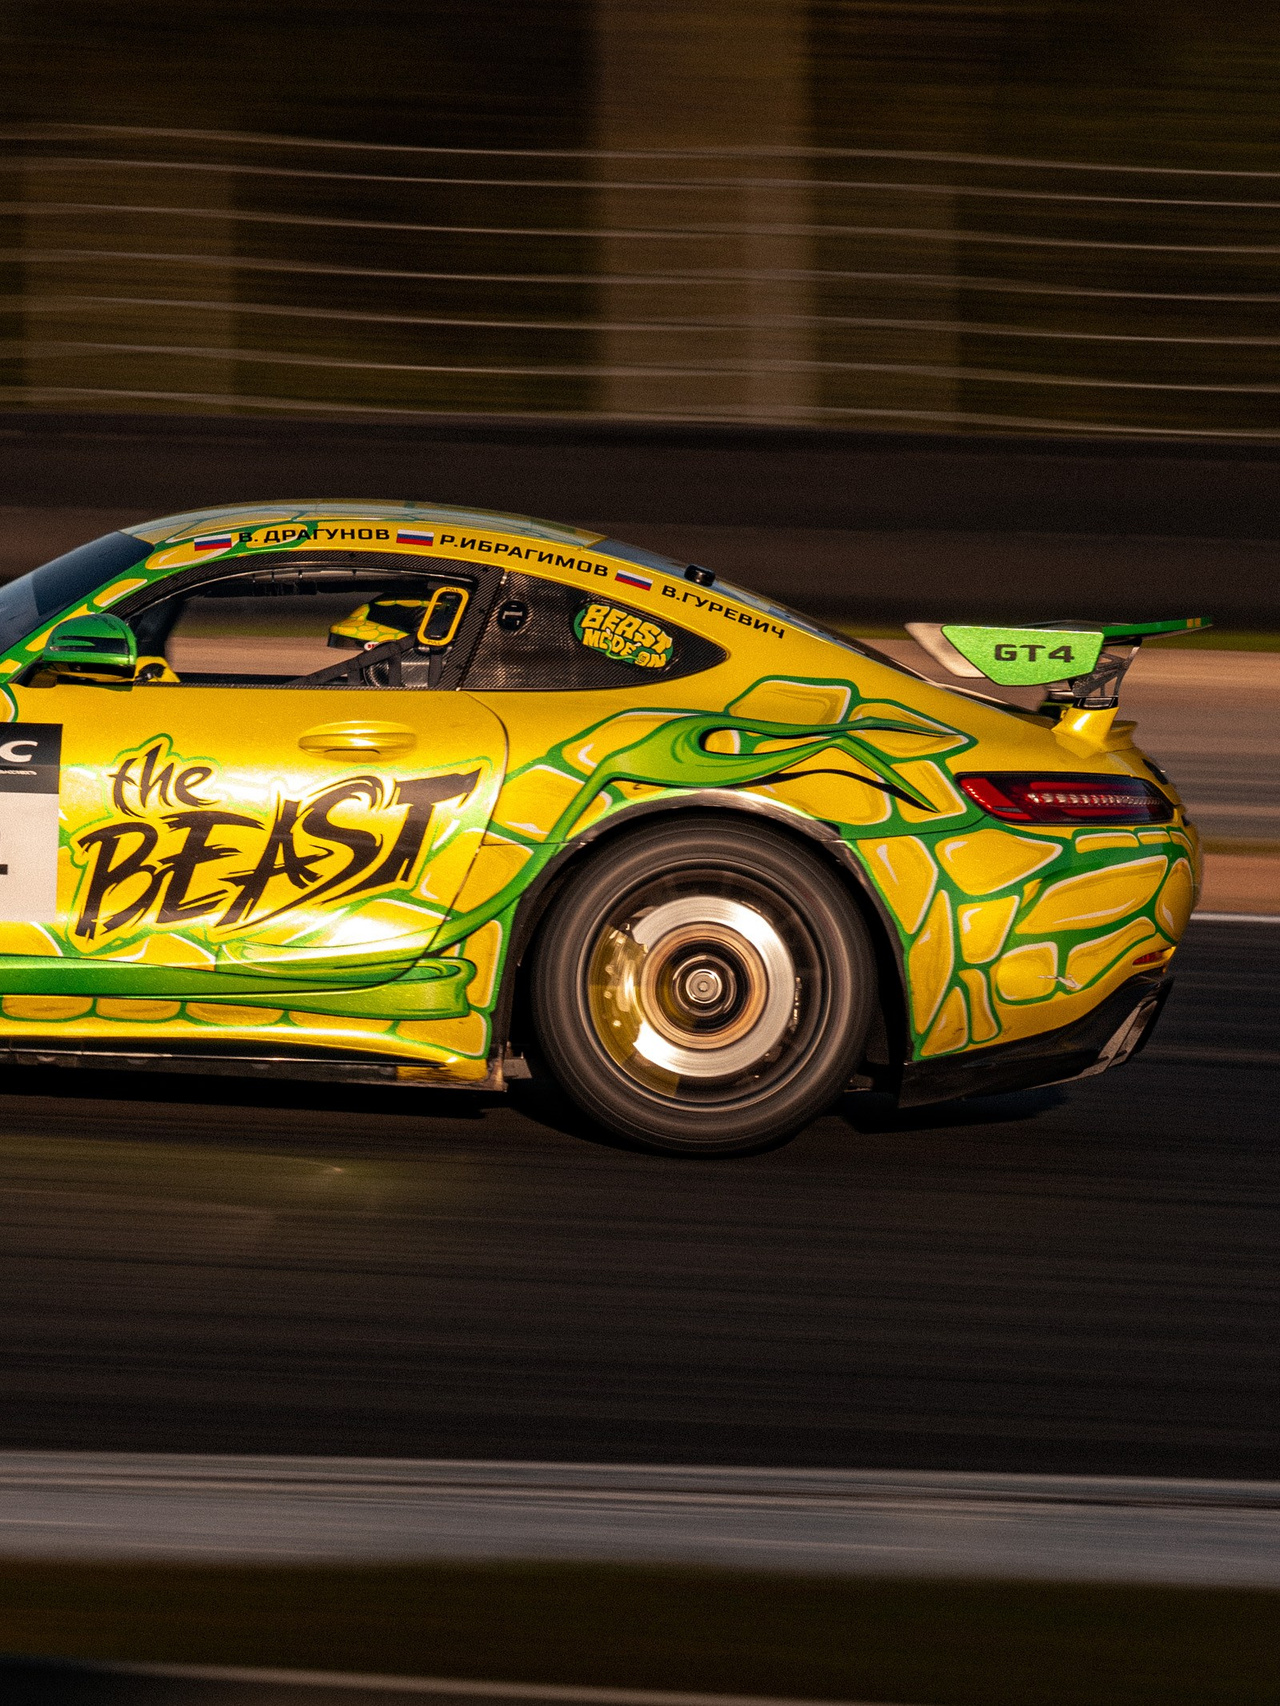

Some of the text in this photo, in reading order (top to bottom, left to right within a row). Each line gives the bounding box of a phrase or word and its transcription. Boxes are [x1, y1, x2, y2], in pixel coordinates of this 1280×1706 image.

[238, 528, 390, 544] В. ДРАГУНОВ
[439, 533, 609, 578] Р.ИБРАГИМОВ
[581, 604, 673, 654] BEAST
[661, 584, 786, 640] В.ГУРЕВИЧ
[582, 628, 637, 656] MODE
[634, 651, 667, 668] ON
[993, 643, 1076, 664] GT4
[108, 744, 219, 818] the
[75, 766, 483, 941] BEAST
